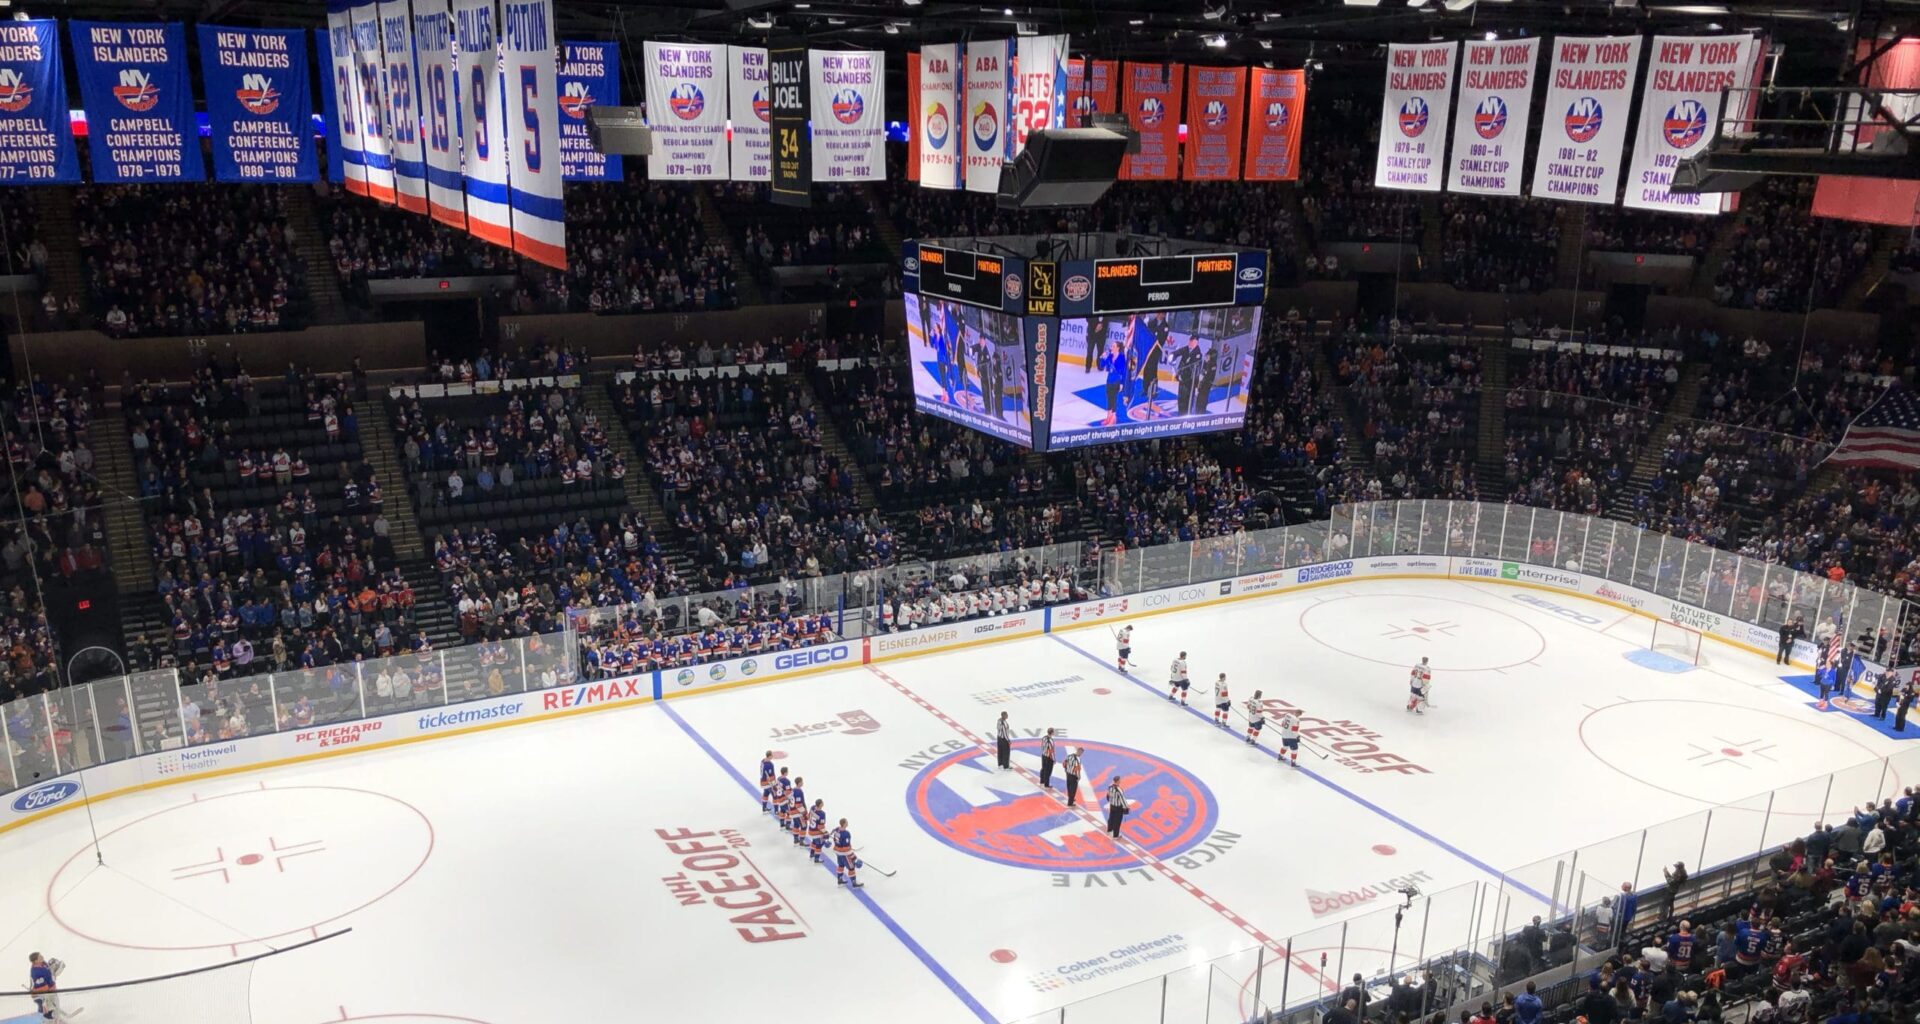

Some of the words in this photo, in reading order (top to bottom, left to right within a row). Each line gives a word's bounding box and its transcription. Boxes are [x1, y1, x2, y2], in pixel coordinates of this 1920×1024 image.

[458, 6, 492, 52] GILLIES
[505, 1, 548, 51] POTVIN
[91, 28, 121, 44] NEW
[128, 29, 165, 44] YORK
[217, 33, 246, 49] NEW
[252, 35, 287, 50] YORK
[94, 47, 168, 62] ISLANDERS
[220, 51, 289, 68] ISLANDERS
[575, 47, 604, 61] YORK
[659, 49, 681, 62] NEW
[686, 50, 712, 63] YORK
[742, 53, 764, 65] NEW
[1393, 50, 1417, 67] NEW
[1421, 48, 1449, 66] YORK
[1470, 46, 1496, 64] NEW
[1500, 44, 1531, 64] YORK
[1560, 43, 1590, 63] NEW
[1595, 42, 1631, 62] YORK
[1660, 42, 1694, 64] NEW
[1700, 42, 1740, 64] YORK
[660, 64, 713, 78] ISLANDERS
[771, 60, 803, 83] BILLY
[823, 57, 843, 69] NEW
[848, 57, 871, 69] YORK
[928, 59, 949, 73] ABA
[976, 56, 998, 72] ABA
[823, 71, 872, 84] ISLANDERS
[1020, 73, 1051, 98] NETS
[1390, 71, 1447, 90] ISLANDERS
[1466, 70, 1528, 89] ISLANDERS
[1555, 69, 1627, 90] ISLANDERS
[1653, 70, 1736, 92] ISLANDERS
[338, 65, 356, 136] 31
[390, 62, 414, 144] 22
[774, 86, 803, 109] JOEL
[427, 64, 449, 153] 19
[471, 64, 488, 161] 9
[111, 119, 173, 131] CAMPBELL
[233, 121, 292, 134] CAMPBELL
[520, 65, 541, 173] 5
[1018, 100, 1051, 144] 32
[106, 134, 182, 147] CONFERENCE
[229, 136, 300, 149] CONFERENCE
[780, 128, 799, 158] 34
[112, 149, 181, 162] CHAMPIONS
[234, 151, 298, 163] CHAMPIONS
[1387, 156, 1417, 168] STANLEY
[1417, 157, 1431, 168] CUP
[1460, 159, 1493, 172] STANLEY
[1493, 161, 1509, 173] CUP
[1548, 163, 1586, 177] STANLEY
[1586, 166, 1604, 178] CUP
[1387, 171, 1428, 184] CHAMPIONS
[1461, 175, 1505, 188] CHAMPIONS
[1548, 180, 1598, 196] CHAMPIONS
[1642, 189, 1700, 205] CHAMPIONS
[978, 260, 1001, 274] PANTHERS
[1098, 265, 1138, 278] ISLANDERS
[1197, 260, 1233, 272] PANTHERS
[1148, 291, 1170, 302] PERIOD
[1029, 301, 1054, 312] LIVE
[1051, 435, 1069, 444] Gave
[1070, 433, 1090, 443] proof
[1092, 430, 1119, 440] through
[1134, 425, 1152, 435] night
[1154, 424, 1168, 432] that
[1183, 421, 1195, 429] flag
[1211, 418, 1224, 426] still
[1309, 570, 1335, 582] SAVINGS
[1335, 569, 1353, 577] BANK
[1310, 560, 1354, 574] RIDGEWOOD
[1459, 566, 1473, 575] LIVE
[1474, 567, 1497, 577] GAMES
[1507, 566, 1579, 587] enterprise
[1143, 592, 1171, 607] ICON
[1178, 588, 1206, 602] ICON
[1622, 594, 1645, 607] LIGHT
[1512, 594, 1603, 624] GEICO
[1671, 603, 1721, 625] NATURE'S
[974, 624, 994, 634] 1050
[1003, 618, 1026, 629] ESPN
[1670, 612, 1714, 632] BOUNTY
[1749, 628, 1774, 641] Cohen
[775, 645, 849, 670] GEICO
[1004, 675, 1085, 693] Northwell
[543, 678, 640, 710] RE/MAX
[1014, 686, 1067, 700] Health
[418, 702, 523, 730] ticketmaster
[296, 733, 314, 743] PC
[317, 721, 382, 739] RICHARD
[769, 719, 842, 740] Jake's
[1333, 719, 1383, 742] NHL
[319, 738, 329, 747] &
[332, 734, 360, 746] SON
[181, 745, 237, 761] Northwell
[898, 738, 966, 771] NYCB
[182, 758, 219, 771] Health
[1334, 757, 1374, 774] 2019
[25, 784, 66, 809] Ford
[718, 829, 752, 849] 2019
[1173, 830, 1242, 870] NYCB
[654, 827, 808, 944] FACE-OFF
[1052, 871, 1155, 888] LIVE
[662, 872, 706, 906] NHL
[1309, 882, 1377, 916] Coors
[1371, 870, 1433, 896] LIGHT
[1057, 954, 1108, 976] Cohen
[1108, 933, 1184, 968] Children's
[1678, 945, 1691, 958] 91
[1068, 957, 1139, 985] Northwell
[1140, 942, 1188, 967] Health
